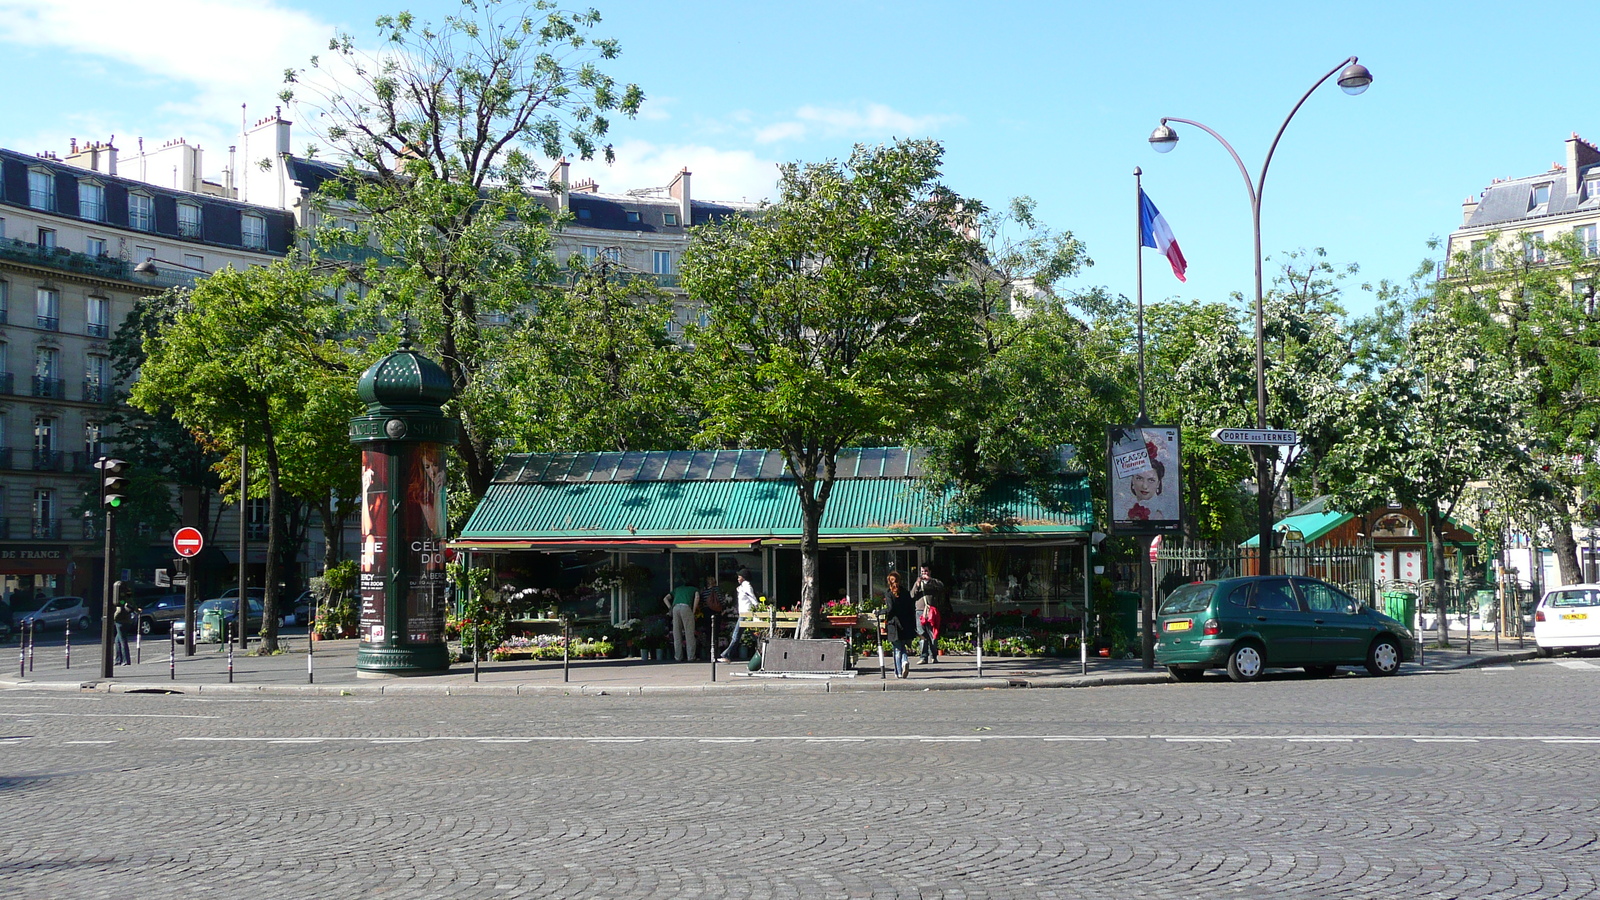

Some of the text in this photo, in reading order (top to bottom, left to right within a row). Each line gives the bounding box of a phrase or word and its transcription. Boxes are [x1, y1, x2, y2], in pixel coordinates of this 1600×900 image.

[1224, 432, 1249, 440] PORTE
[1262, 433, 1293, 441] TERNES
[1115, 451, 1148, 466] PICASSO
[1, 550, 60, 559] DE FRANCE
